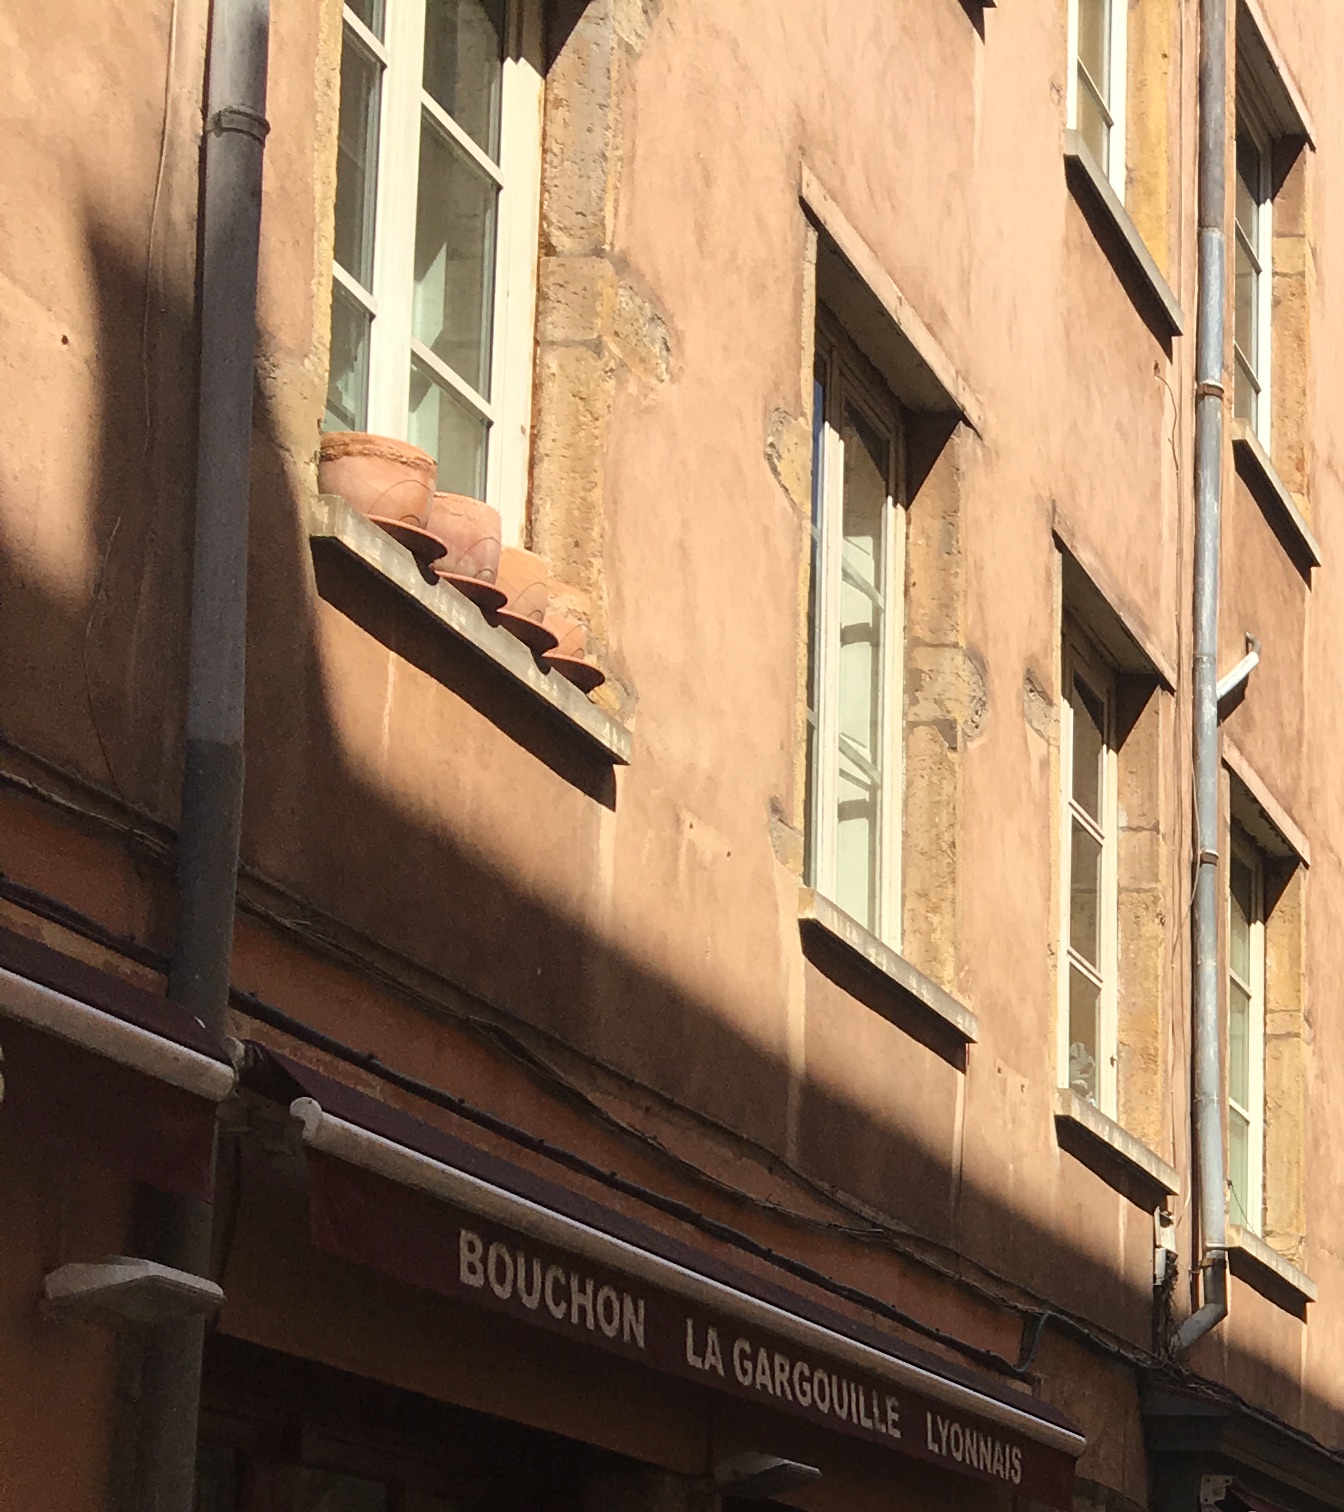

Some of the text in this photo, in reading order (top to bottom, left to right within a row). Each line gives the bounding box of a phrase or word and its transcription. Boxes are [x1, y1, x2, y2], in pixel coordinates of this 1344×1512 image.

[457, 1227, 1023, 1486] BOUCHON LA GARGOUILLE LYONNAIS
